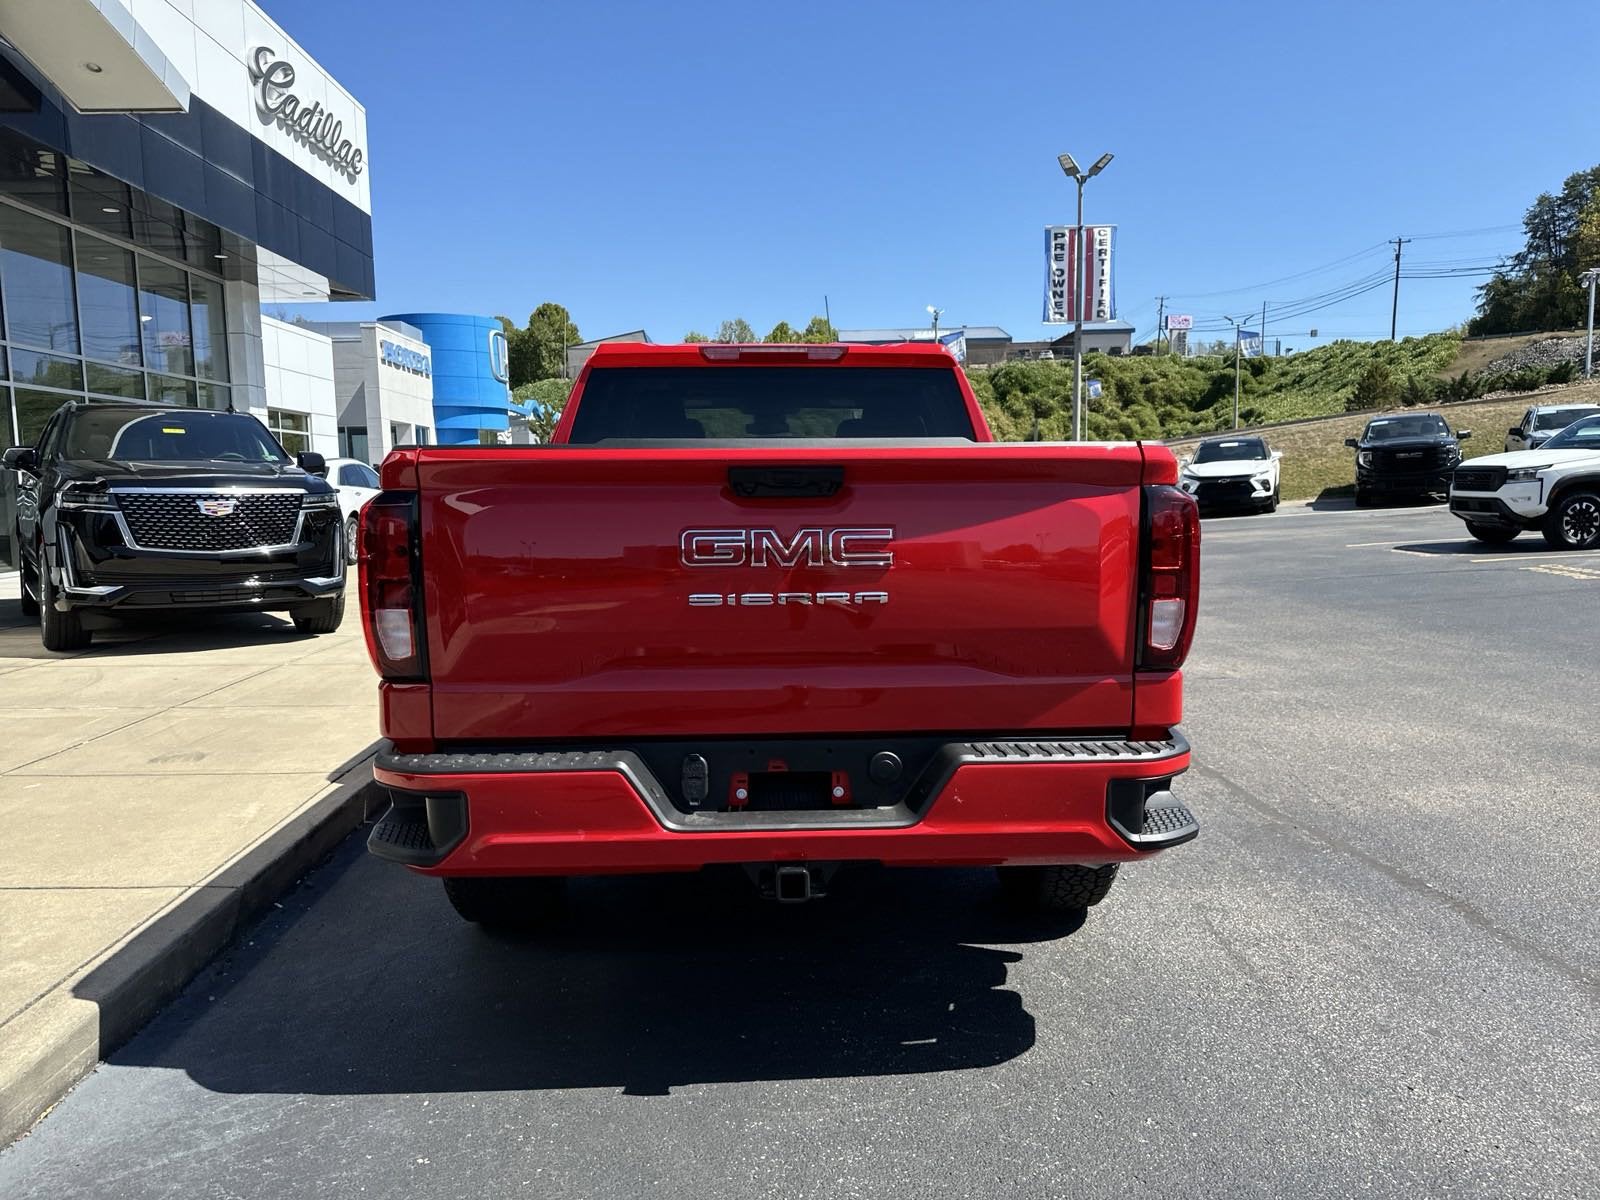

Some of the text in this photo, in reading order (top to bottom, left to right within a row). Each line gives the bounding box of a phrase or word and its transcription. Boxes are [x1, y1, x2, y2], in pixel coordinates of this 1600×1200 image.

[247, 46, 363, 175] Cadillac
[1053, 232, 1066, 261] PRE
[1096, 229, 1108, 318] CERTIFIED
[380, 339, 432, 377] HONDA
[681, 528, 893, 567] GMC
[688, 591, 889, 606] SIERRA
